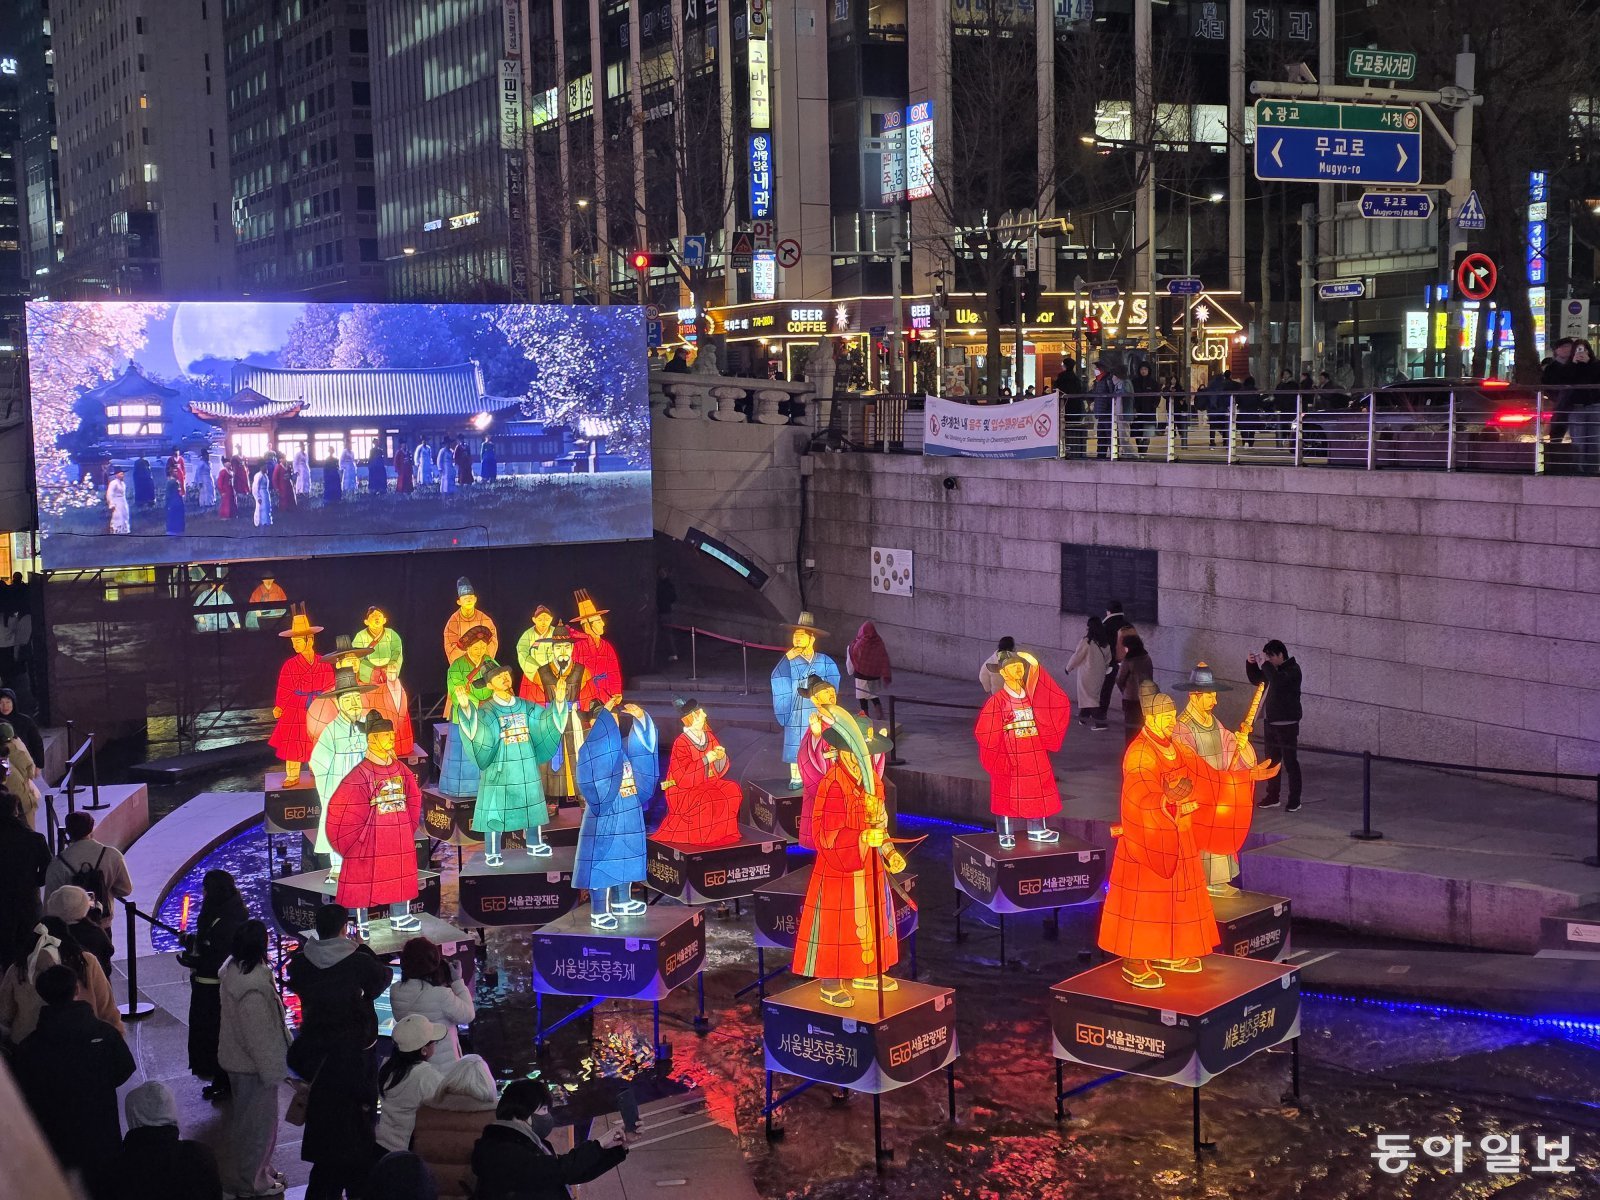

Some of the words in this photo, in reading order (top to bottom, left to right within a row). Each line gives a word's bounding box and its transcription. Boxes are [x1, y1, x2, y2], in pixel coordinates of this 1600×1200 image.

[1252, 9, 1313, 40] 치과
[1354, 54, 1411, 75] 무교동사거리
[751, 51, 767, 107] 고바우
[911, 103, 928, 122] OK
[1276, 107, 1300, 122] 광교
[1381, 112, 1403, 127] 시청
[1315, 137, 1366, 157] 무교로
[909, 128, 919, 182] 당구장
[1320, 162, 1361, 175] Mugyo-ro
[753, 173, 770, 209] 내과
[1364, 202, 1372, 210] 37
[1383, 197, 1408, 206] 무교로
[1419, 202, 1428, 210] 33
[647, 308, 657, 317] 30
[791, 309, 823, 321] BEER
[911, 305, 931, 317] BEER
[648, 322, 657, 334] P
[787, 321, 827, 332] COFFEE
[912, 317, 931, 327] WINE
[969, 418, 982, 431] 음주
[983, 418, 991, 432] 및
[727, 864, 771, 880] 서울관광재단
[1042, 874, 1090, 888] 서울관광재단
[508, 895, 560, 906] 서울관광재단
[552, 958, 636, 982] 서울빛초롱축제
[911, 1025, 947, 1051] 서울관광재단
[1105, 1029, 1166, 1054] 서울관광재단
[777, 1033, 858, 1068] 서울빛초롱축제
